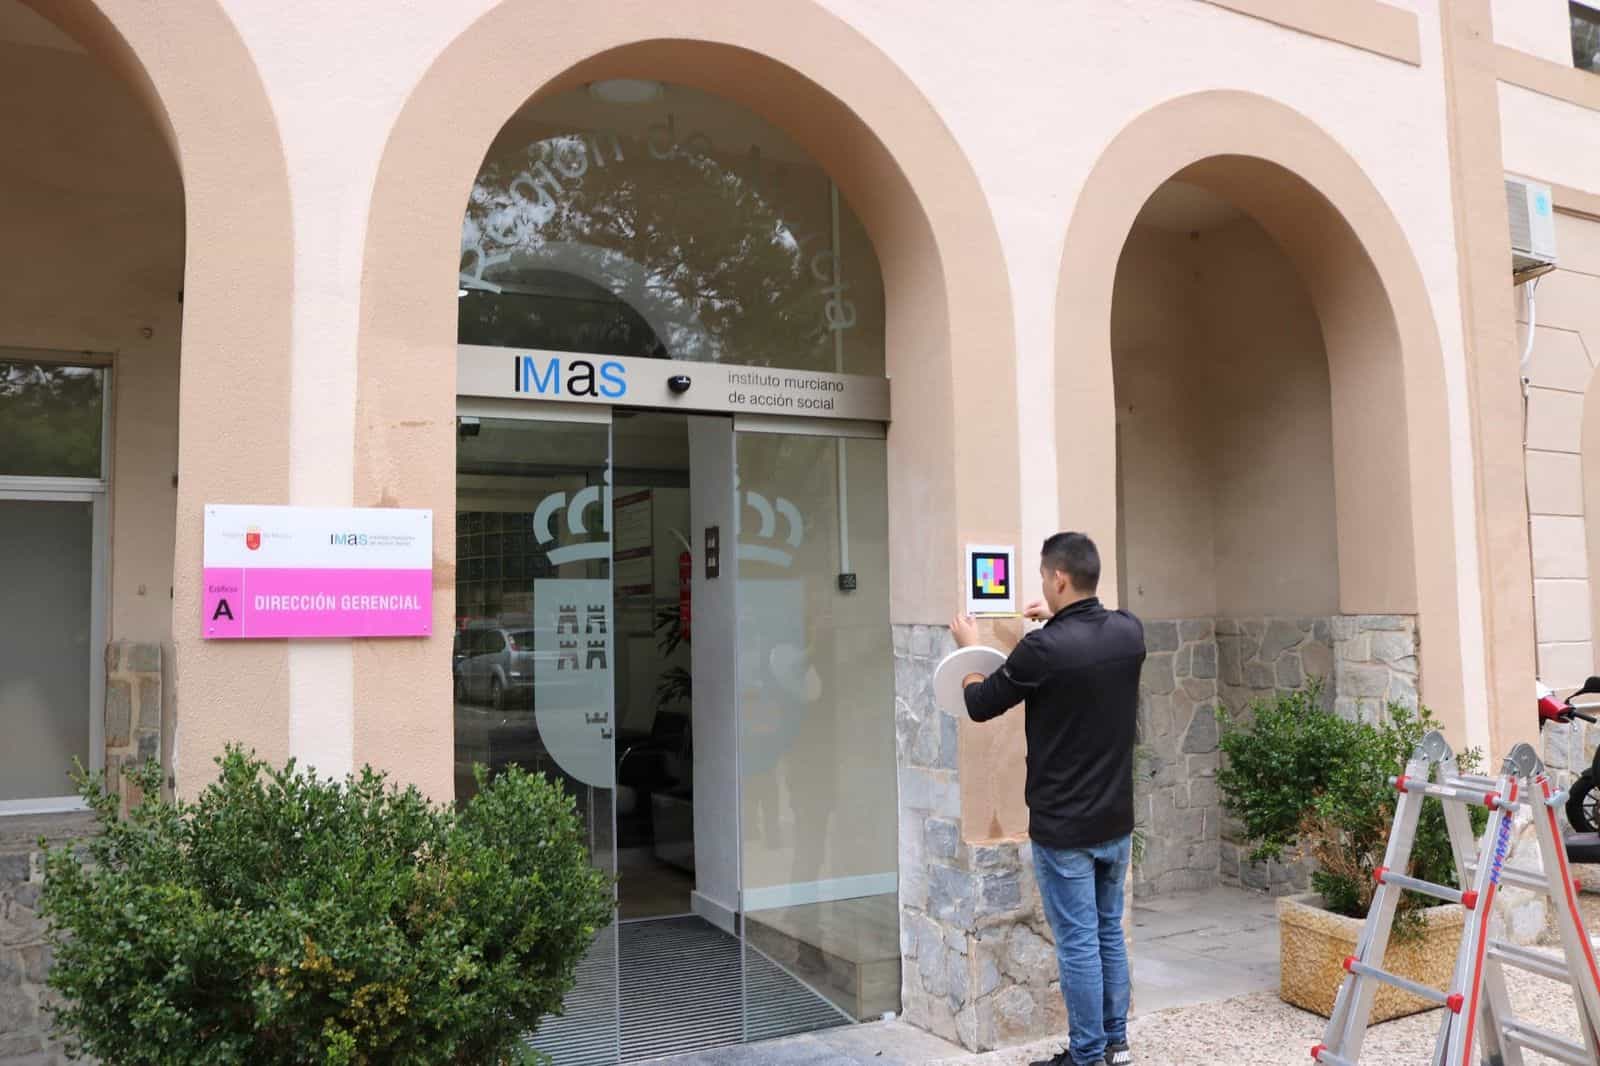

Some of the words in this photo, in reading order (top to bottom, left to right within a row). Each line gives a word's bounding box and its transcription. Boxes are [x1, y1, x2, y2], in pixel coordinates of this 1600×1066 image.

[728, 370, 780, 387] instituto
[784, 377, 844, 392] murciano
[728, 390, 746, 404] de
[750, 391, 793, 407] acción
[797, 397, 834, 409] social
[212, 599, 234, 621] A
[254, 592, 336, 610] DIRECCIÓN
[341, 594, 421, 610] GERENCIAL
[1112, 1051, 1130, 1064] NIK
